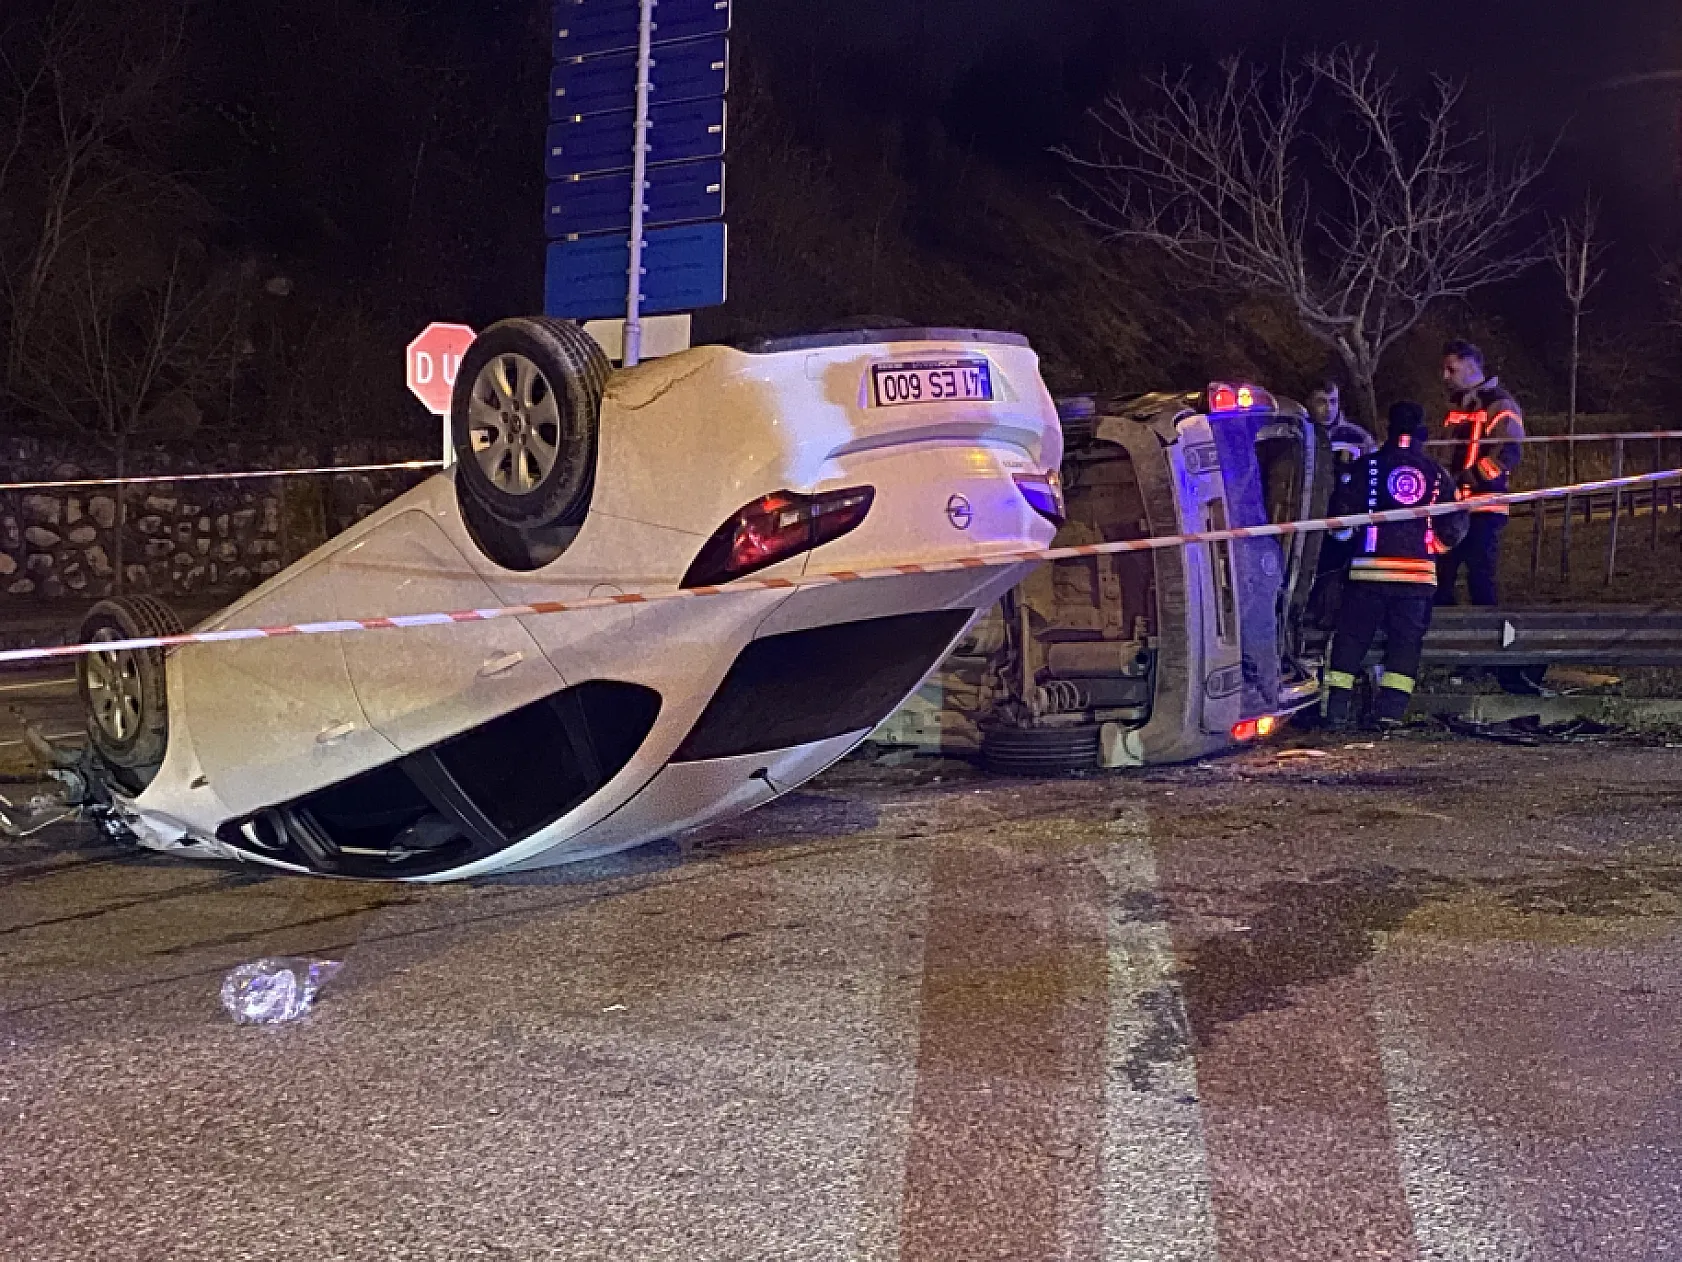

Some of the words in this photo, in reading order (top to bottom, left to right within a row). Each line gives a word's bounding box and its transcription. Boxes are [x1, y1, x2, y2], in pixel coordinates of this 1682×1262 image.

[416, 351, 462, 385] DU
[885, 373, 922, 402] 600
[929, 371, 957, 398] ES
[962, 370, 979, 396] 41
